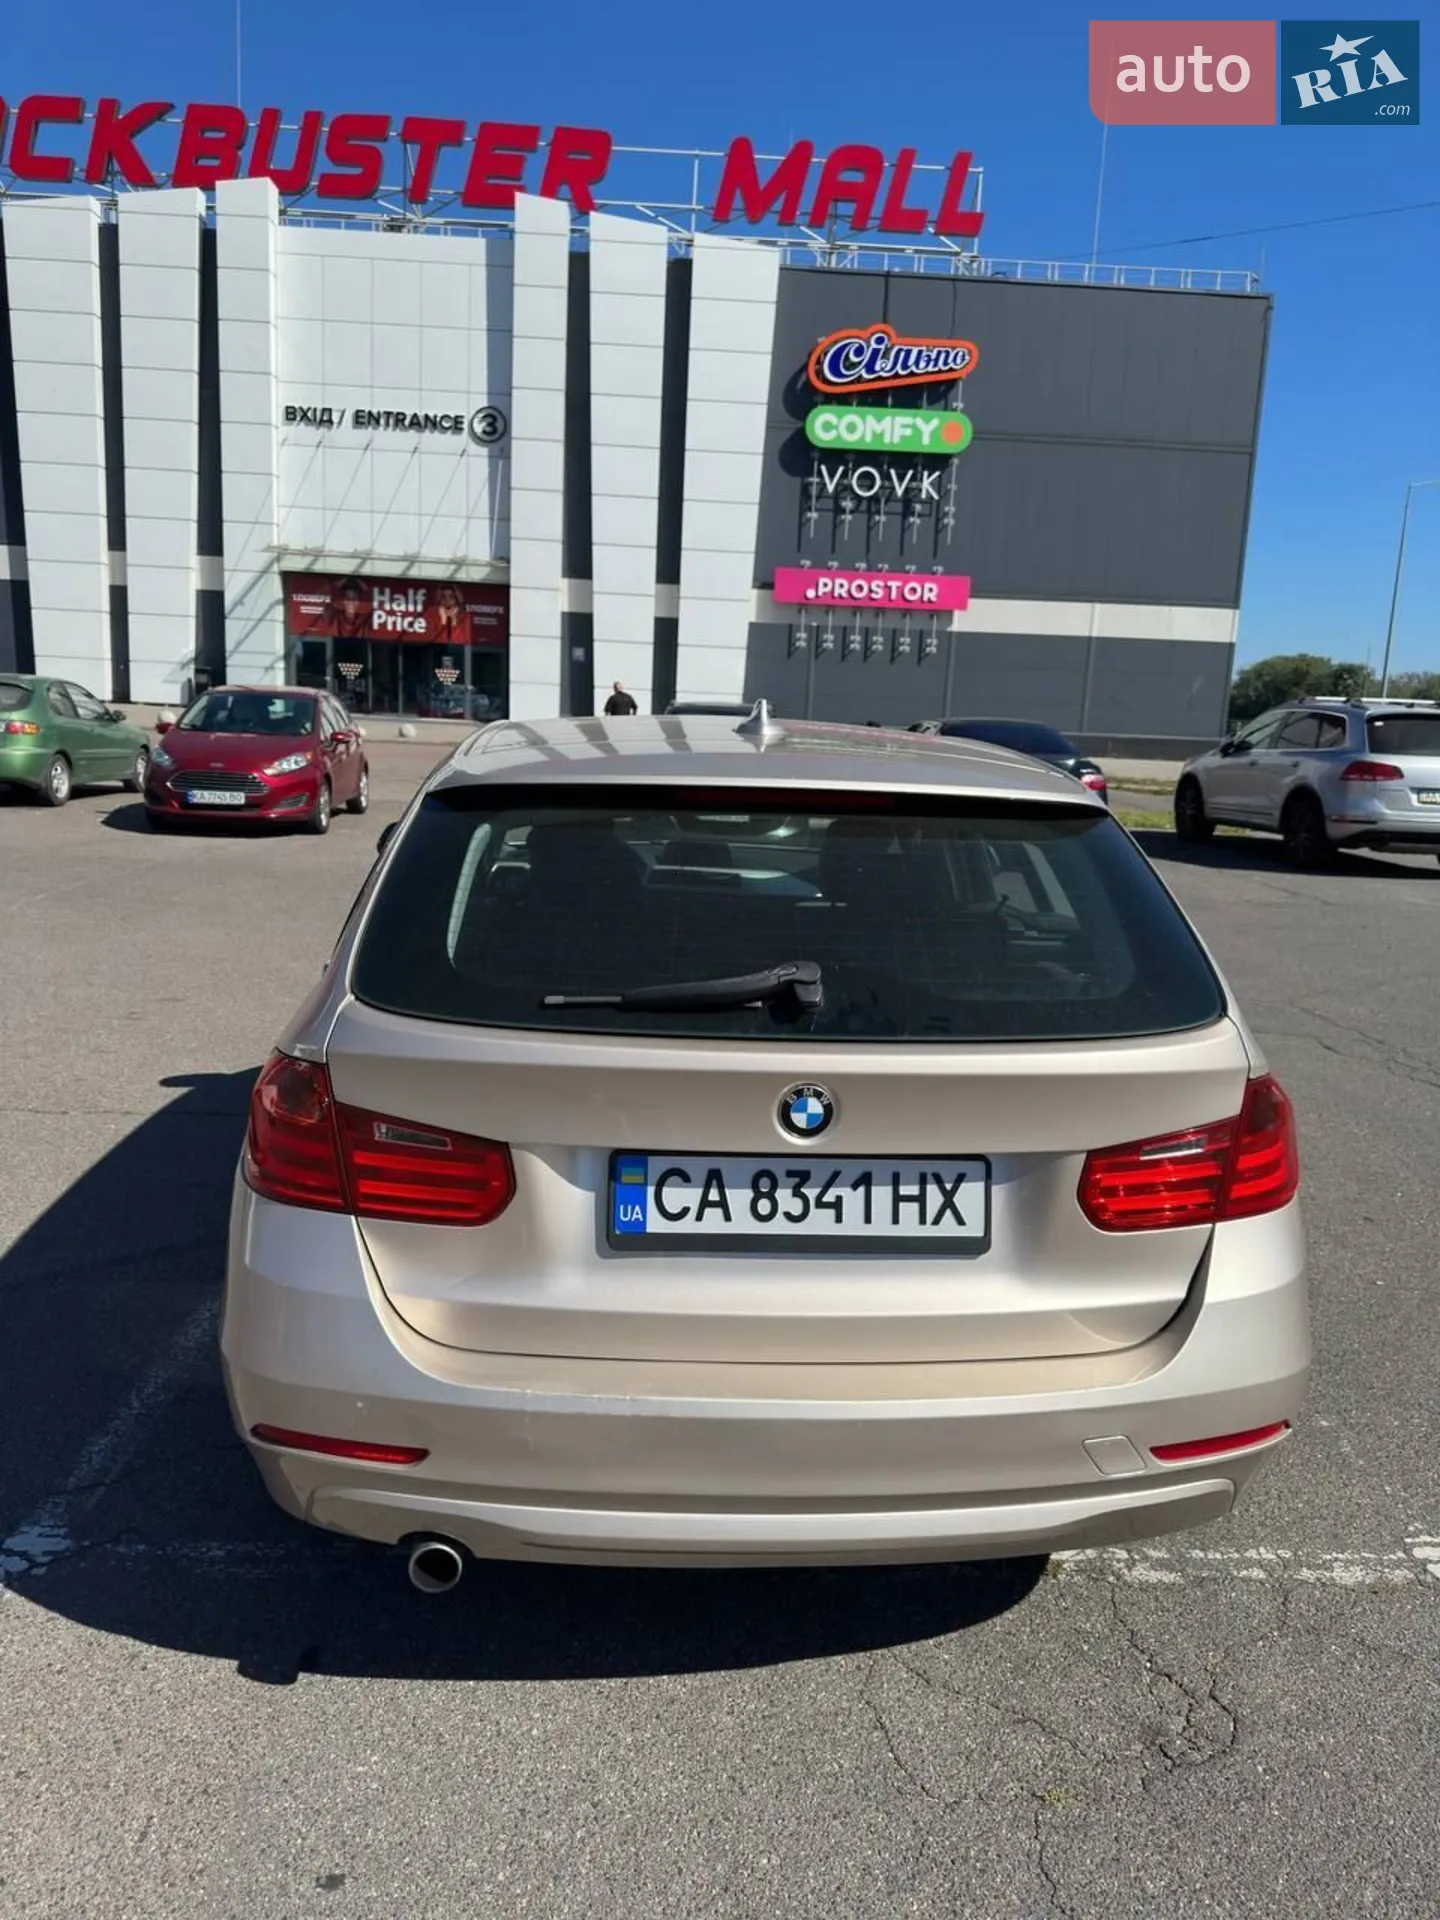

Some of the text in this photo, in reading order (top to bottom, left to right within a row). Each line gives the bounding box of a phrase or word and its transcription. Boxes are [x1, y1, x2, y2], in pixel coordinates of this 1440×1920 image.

[0, 94, 985, 237] CKBUSTER MALL
[823, 332, 972, 382] Сільпо
[354, 409, 465, 432] ENTRANCE
[814, 412, 940, 446] COMFY
[820, 464, 941, 500] VOVK
[372, 587, 427, 613] Half
[372, 610, 427, 633] Price
[786, 1088, 831, 1105] BMW
[654, 1167, 967, 1226] CA 8341 HX
[620, 1204, 644, 1223] UA
